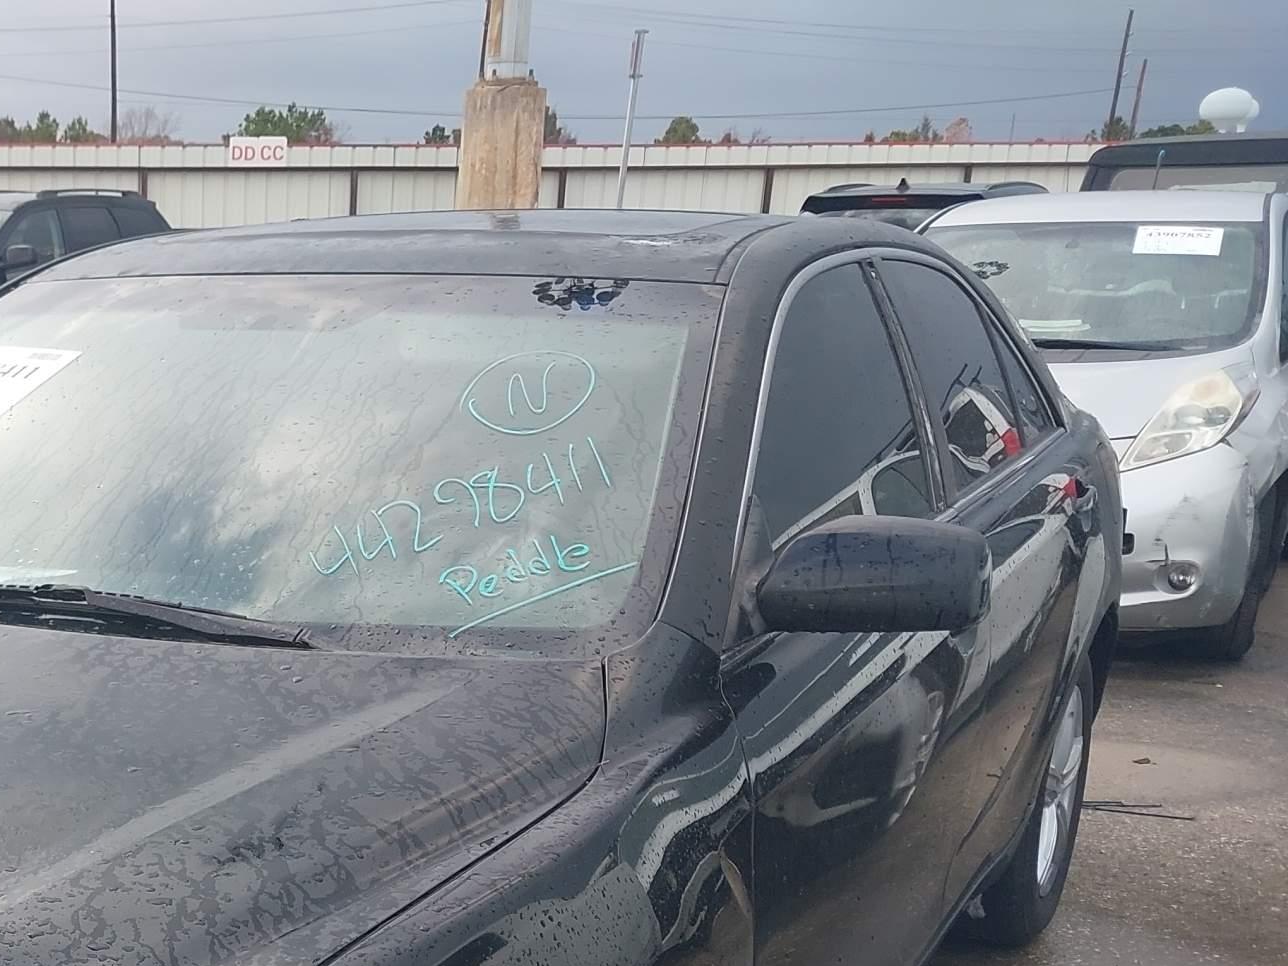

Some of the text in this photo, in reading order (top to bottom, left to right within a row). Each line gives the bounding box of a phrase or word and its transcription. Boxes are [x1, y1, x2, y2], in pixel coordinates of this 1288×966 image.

[231, 145, 285, 161] DD CC
[507, 360, 557, 417] N
[308, 436, 612, 577] 44298411
[438, 535, 592, 606] Peddle
